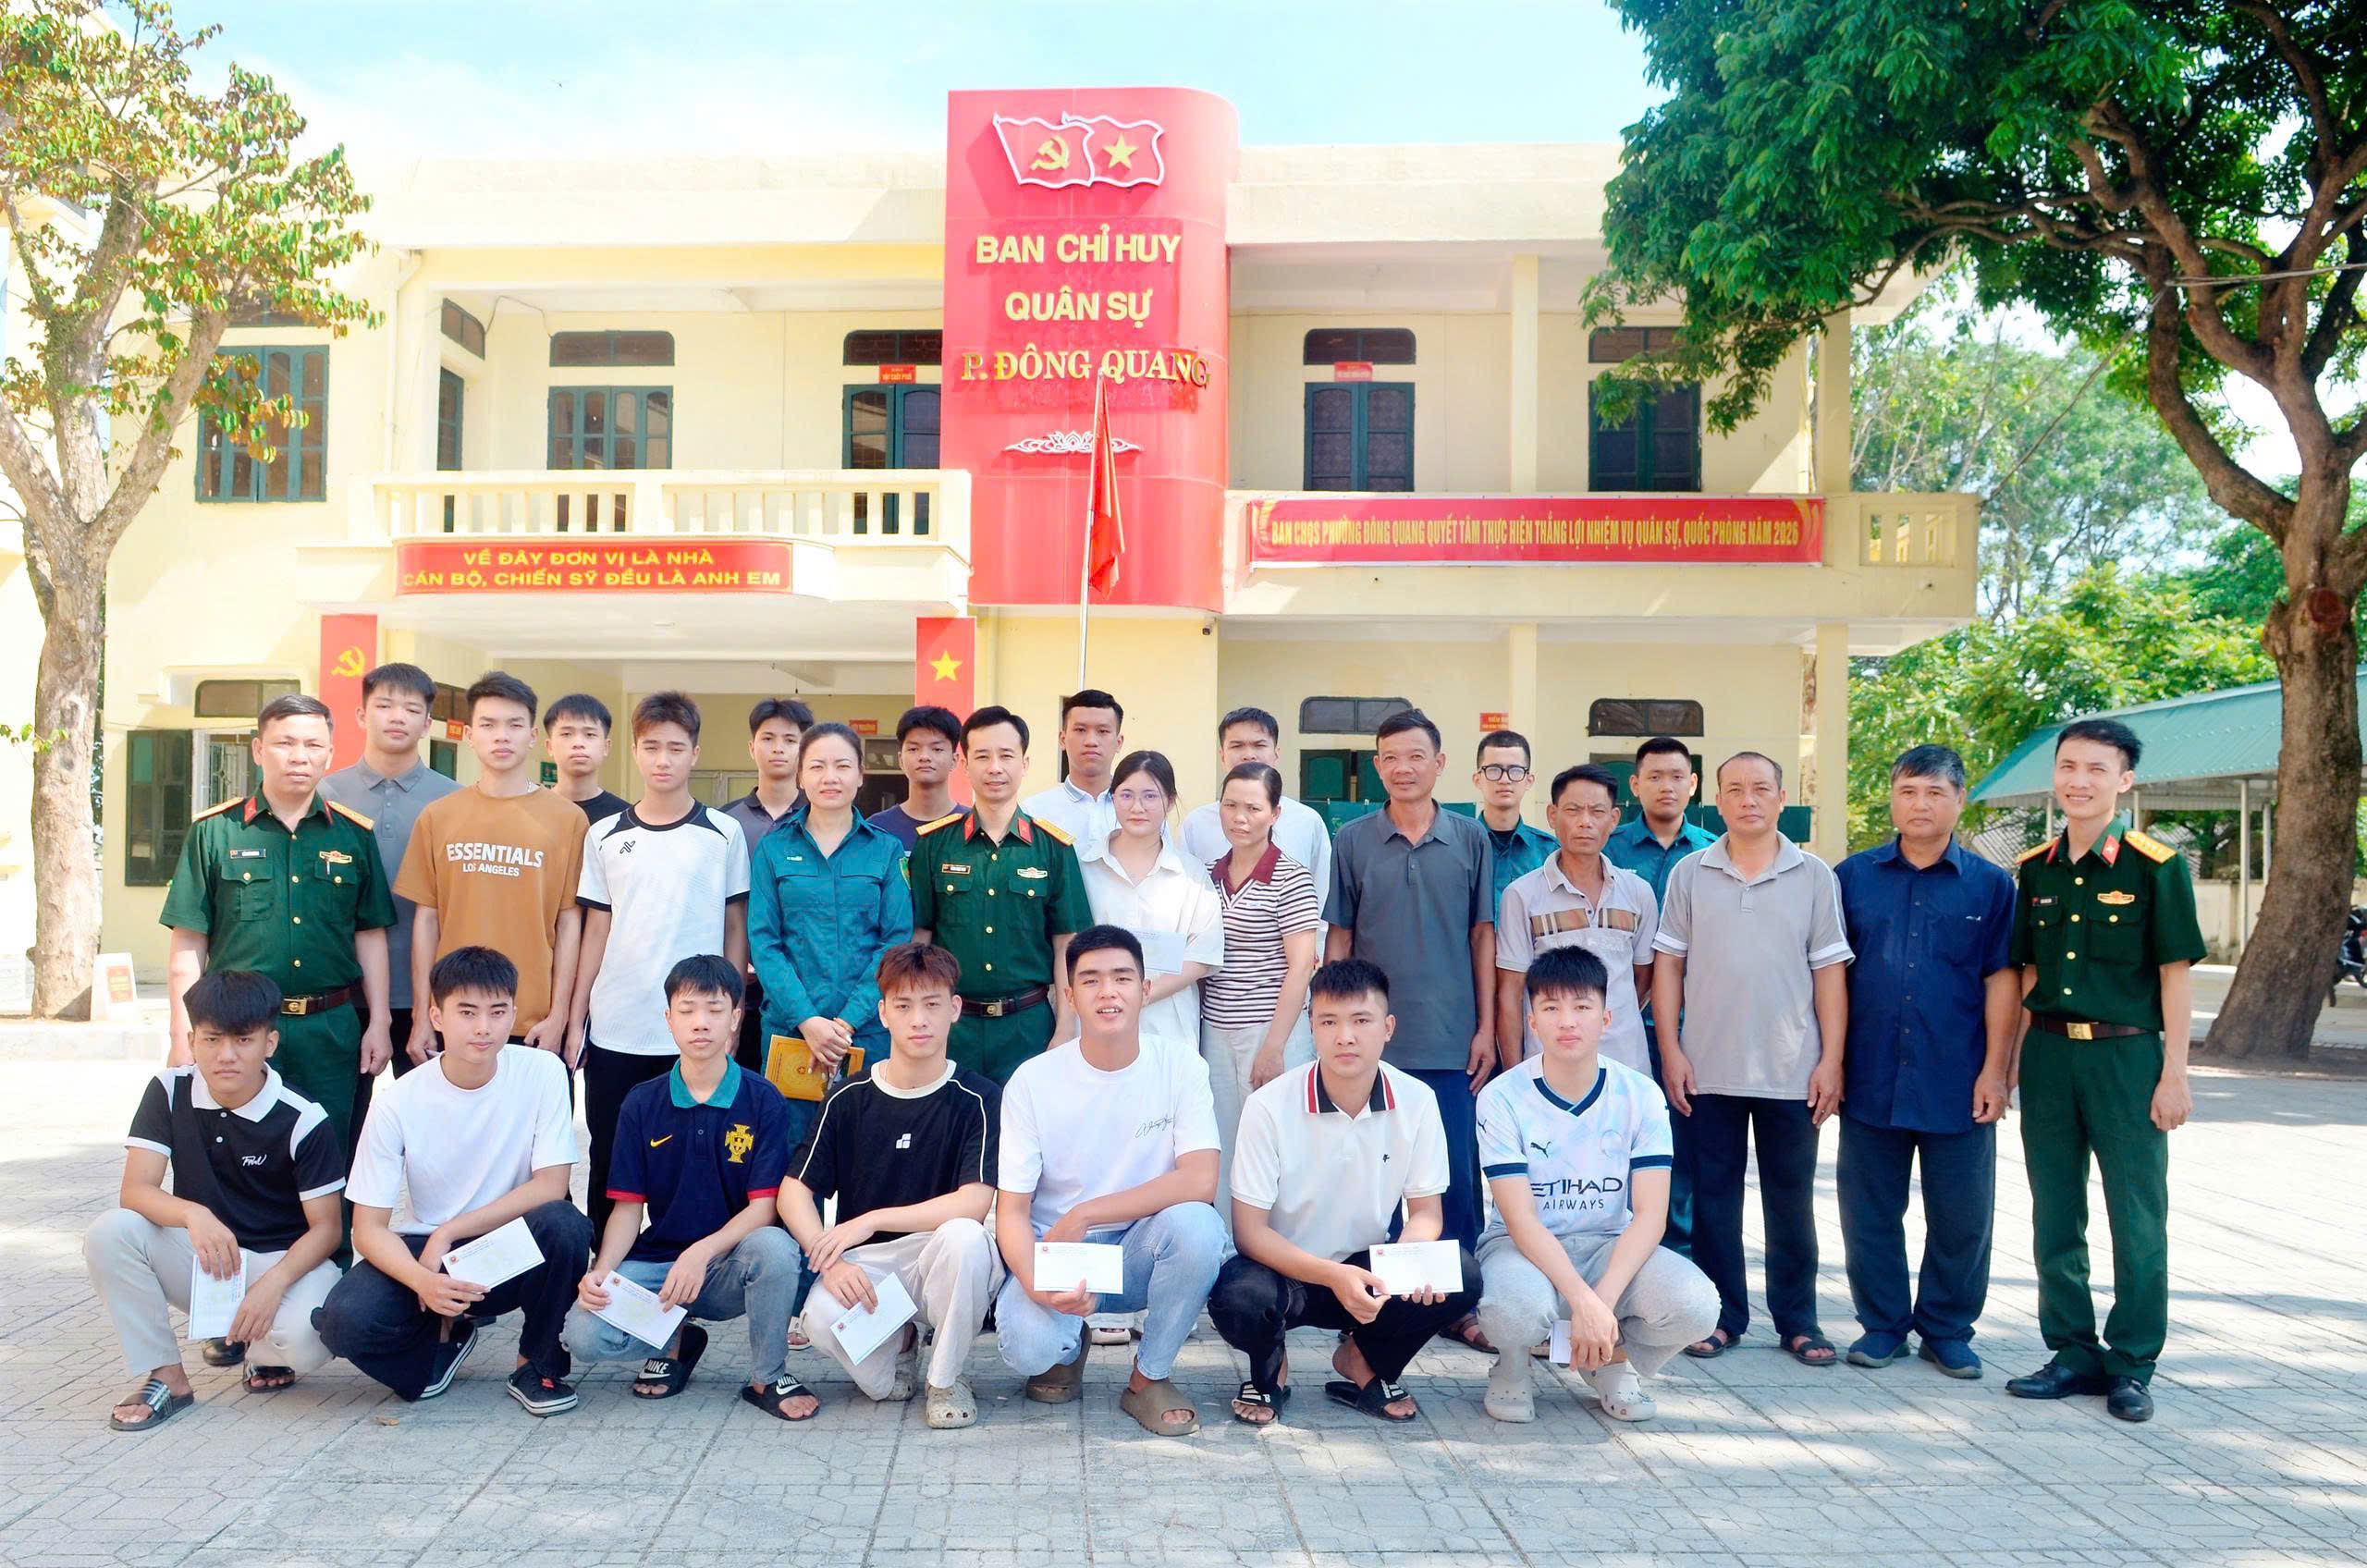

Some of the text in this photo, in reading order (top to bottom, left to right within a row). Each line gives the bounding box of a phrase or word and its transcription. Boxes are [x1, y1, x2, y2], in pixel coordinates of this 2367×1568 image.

[975, 224, 1182, 263] BAN CHỈ HUY
[1005, 285, 1154, 328] QUÂN SỰ
[962, 342, 1210, 388] P. ĐÔNG QUANG
[1271, 521, 1292, 545] BAN
[1321, 514, 1362, 545] PHƯỜNG
[1363, 514, 1391, 545] ĐÔNG
[1392, 520, 1425, 547] QUANG
[1427, 512, 1458, 547] QUYẾT
[1459, 514, 1480, 545] TÂM
[1481, 518, 1507, 550] THỰC
[1508, 514, 1533, 550] HIỆN
[1535, 509, 1567, 545] THẮNG
[1569, 517, 1584, 550] LỢI
[1587, 515, 1619, 550] NHIỆM
[1621, 520, 1634, 550] VỤ
[1683, 511, 1711, 547] QUỐC
[1712, 514, 1747, 545] PHÒNG
[1748, 516, 1772, 545] NĂM
[462, 547, 714, 568] VỀ ĐÂY ĐƠN VỊ LÀ NHÀ
[403, 568, 781, 588] CÁN BỘ, CHIẾN SỸ ĐỀU LÀ ANH EM
[446, 842, 545, 868] ESSENTIALS
[462, 863, 520, 876] LOS ANGELES
[1530, 1177, 1623, 1197] ETIHAD
[1543, 1198, 1604, 1210] AIRWAYS
[646, 1359, 669, 1374] NIKE
